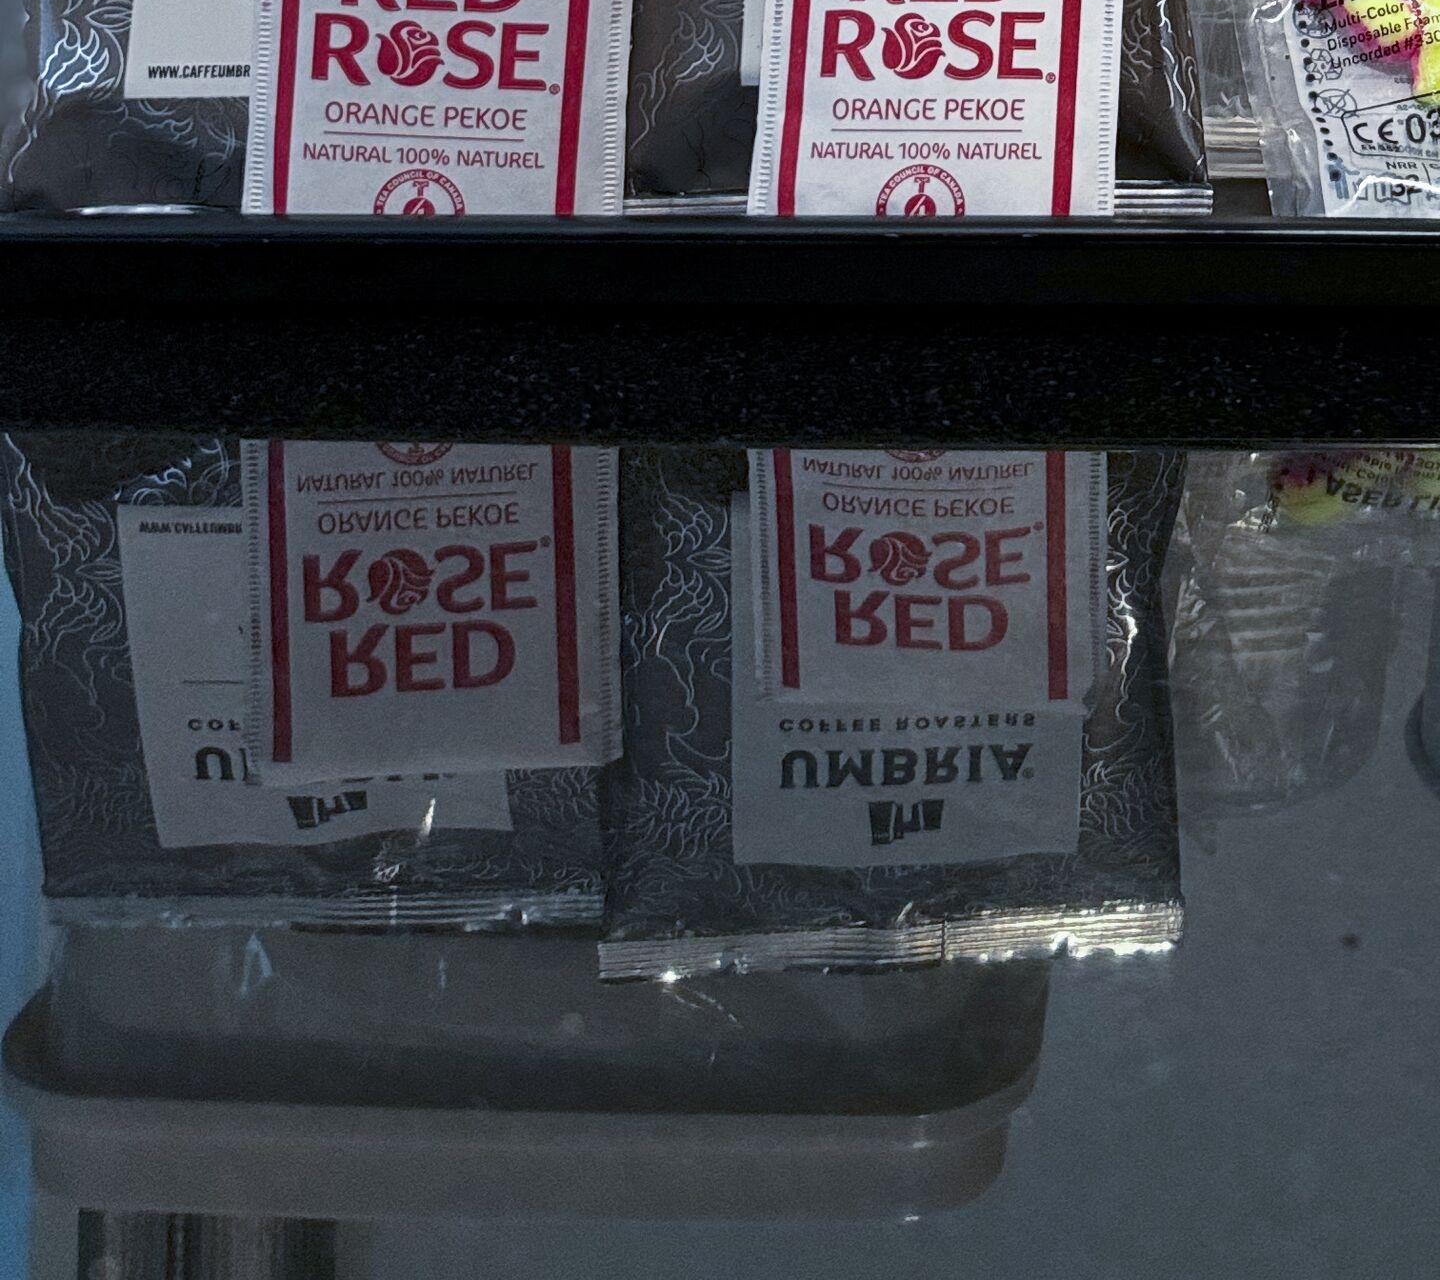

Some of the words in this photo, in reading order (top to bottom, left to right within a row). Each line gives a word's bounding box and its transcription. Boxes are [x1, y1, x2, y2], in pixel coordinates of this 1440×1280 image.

[1323, 1, 1405, 33] Multi-Color
[1327, 22, 1402, 51] Disposable
[1330, 41, 1401, 70] Uncorded
[325, 101, 436, 127] ORANGE
[444, 106, 528, 130] PEKOE
[833, 98, 937, 121] ORANGE
[944, 98, 1025, 121] PEKOE
[303, 143, 392, 164] NATURAL
[396, 147, 450, 166] 100%
[457, 150, 545, 169] NATUREL
[810, 142, 894, 160] NATURAL
[899, 142, 951, 160] 100%
[956, 142, 1043, 160] NATUREL
[376, 190, 389, 207] TEA
[386, 171, 425, 190] COUNCIL
[426, 171, 440, 180] OF
[439, 177, 464, 209] CANADA
[879, 188, 891, 205] TEA
[889, 165, 926, 187] COUNCIL
[927, 166, 941, 175] OF
[940, 172, 964, 205] CANADA
